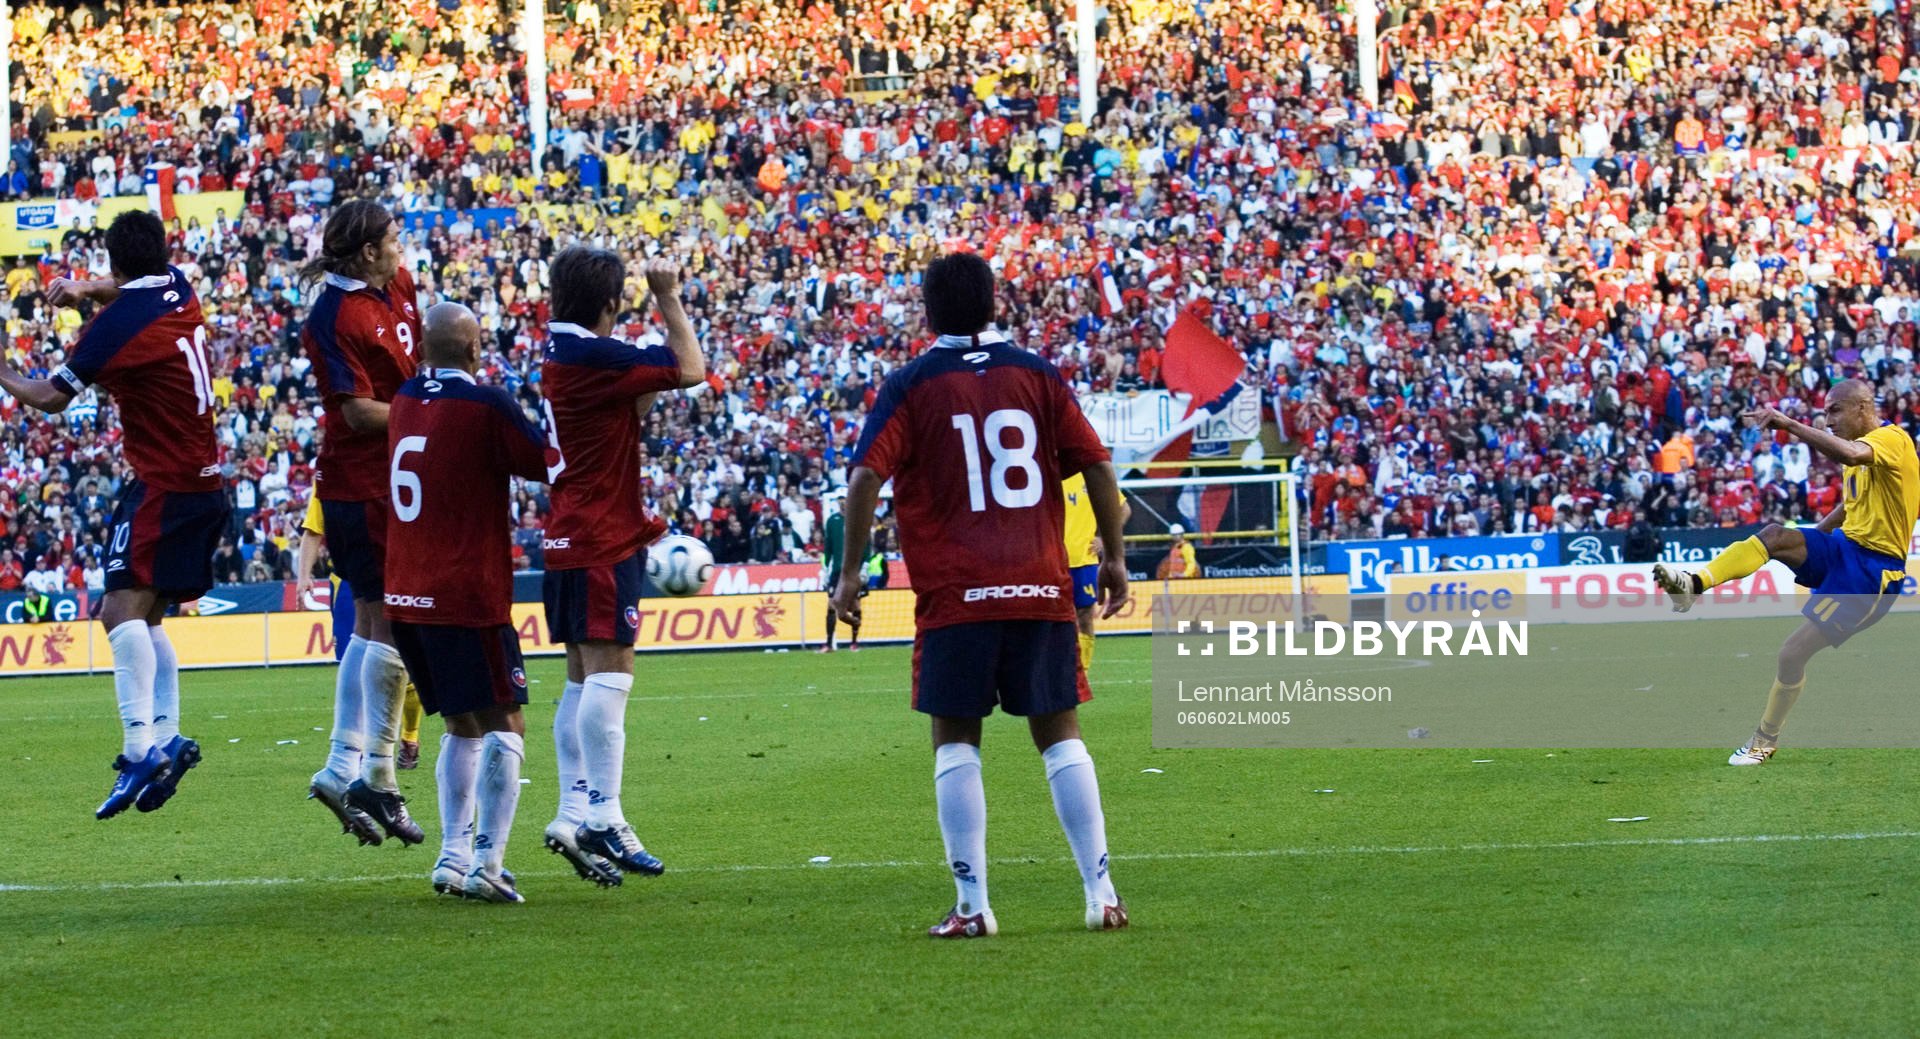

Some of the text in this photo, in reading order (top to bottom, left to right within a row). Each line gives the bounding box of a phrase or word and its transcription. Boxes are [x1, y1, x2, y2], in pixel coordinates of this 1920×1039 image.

[396, 321, 414, 357] 9
[952, 408, 1043, 512] 18
[390, 435, 428, 523] 6
[108, 521, 130, 556] 10
[963, 584, 1061, 602] BROOKS
[1405, 581, 1513, 614] office
